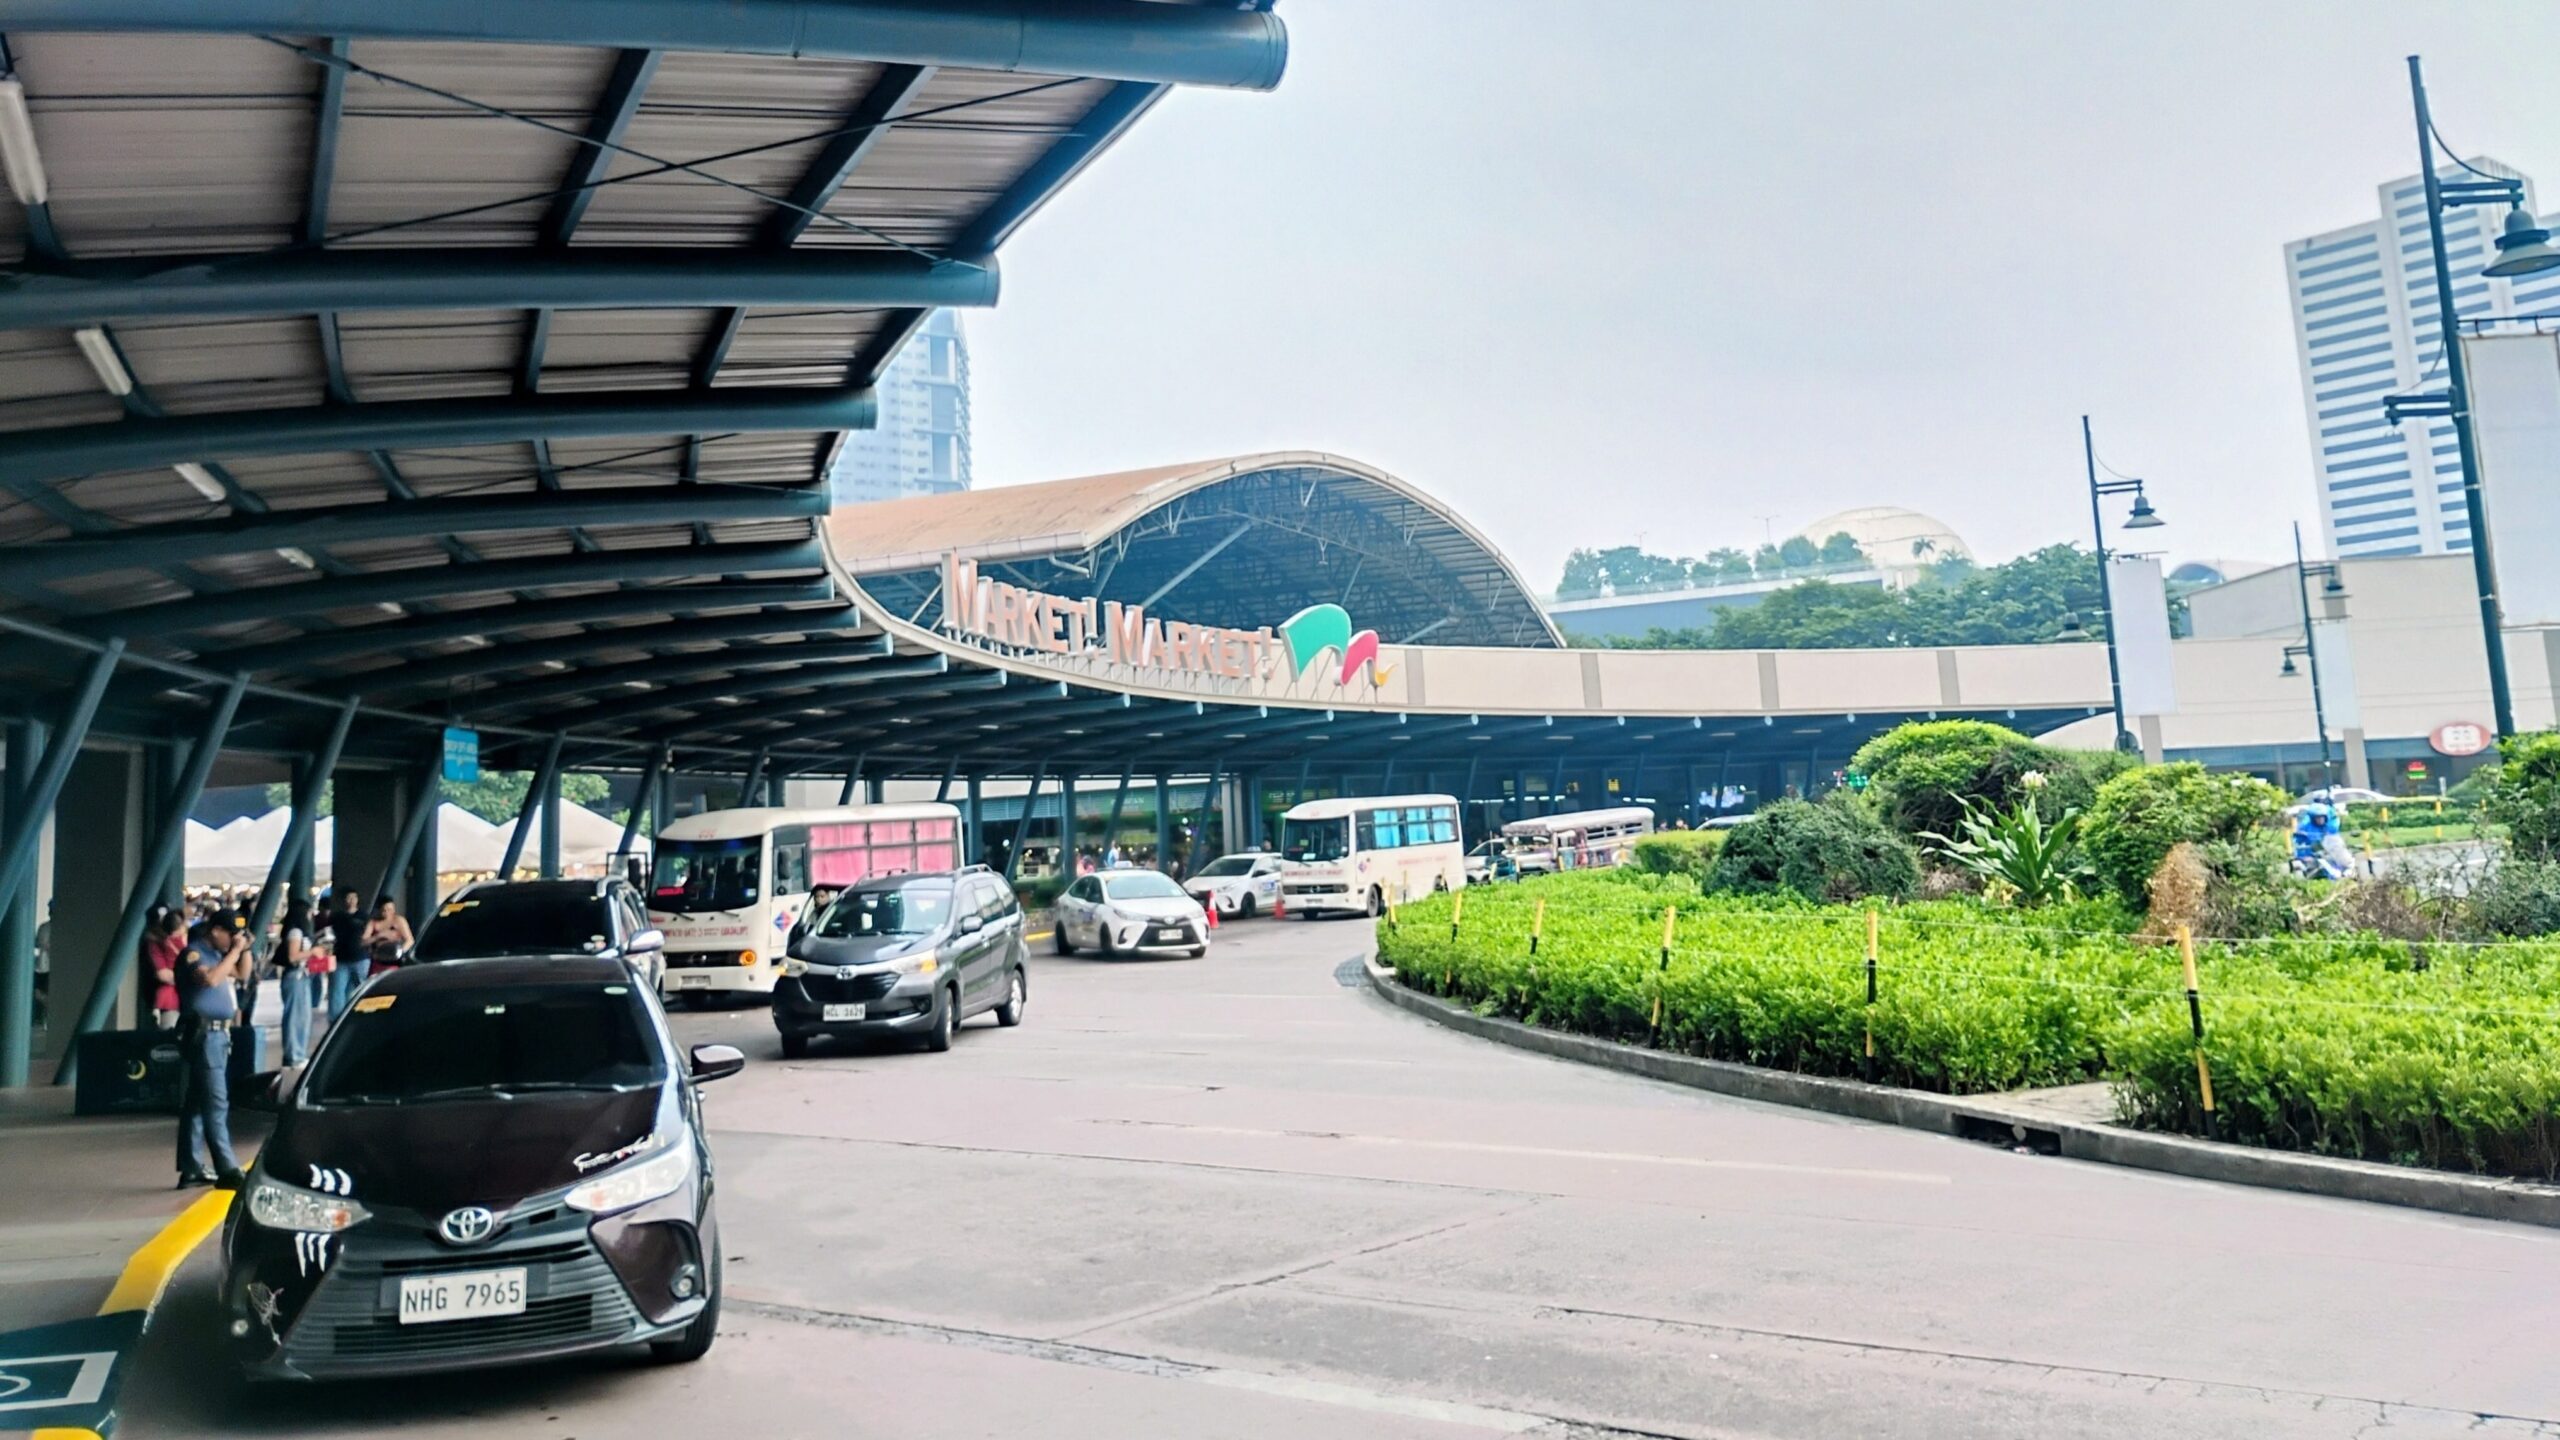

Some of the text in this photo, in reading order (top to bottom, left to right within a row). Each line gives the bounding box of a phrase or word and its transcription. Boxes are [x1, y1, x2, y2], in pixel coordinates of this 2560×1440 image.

[942, 553, 1274, 679] MARKET! MARKET!
[405, 1280, 521, 1313] NHG 7965
